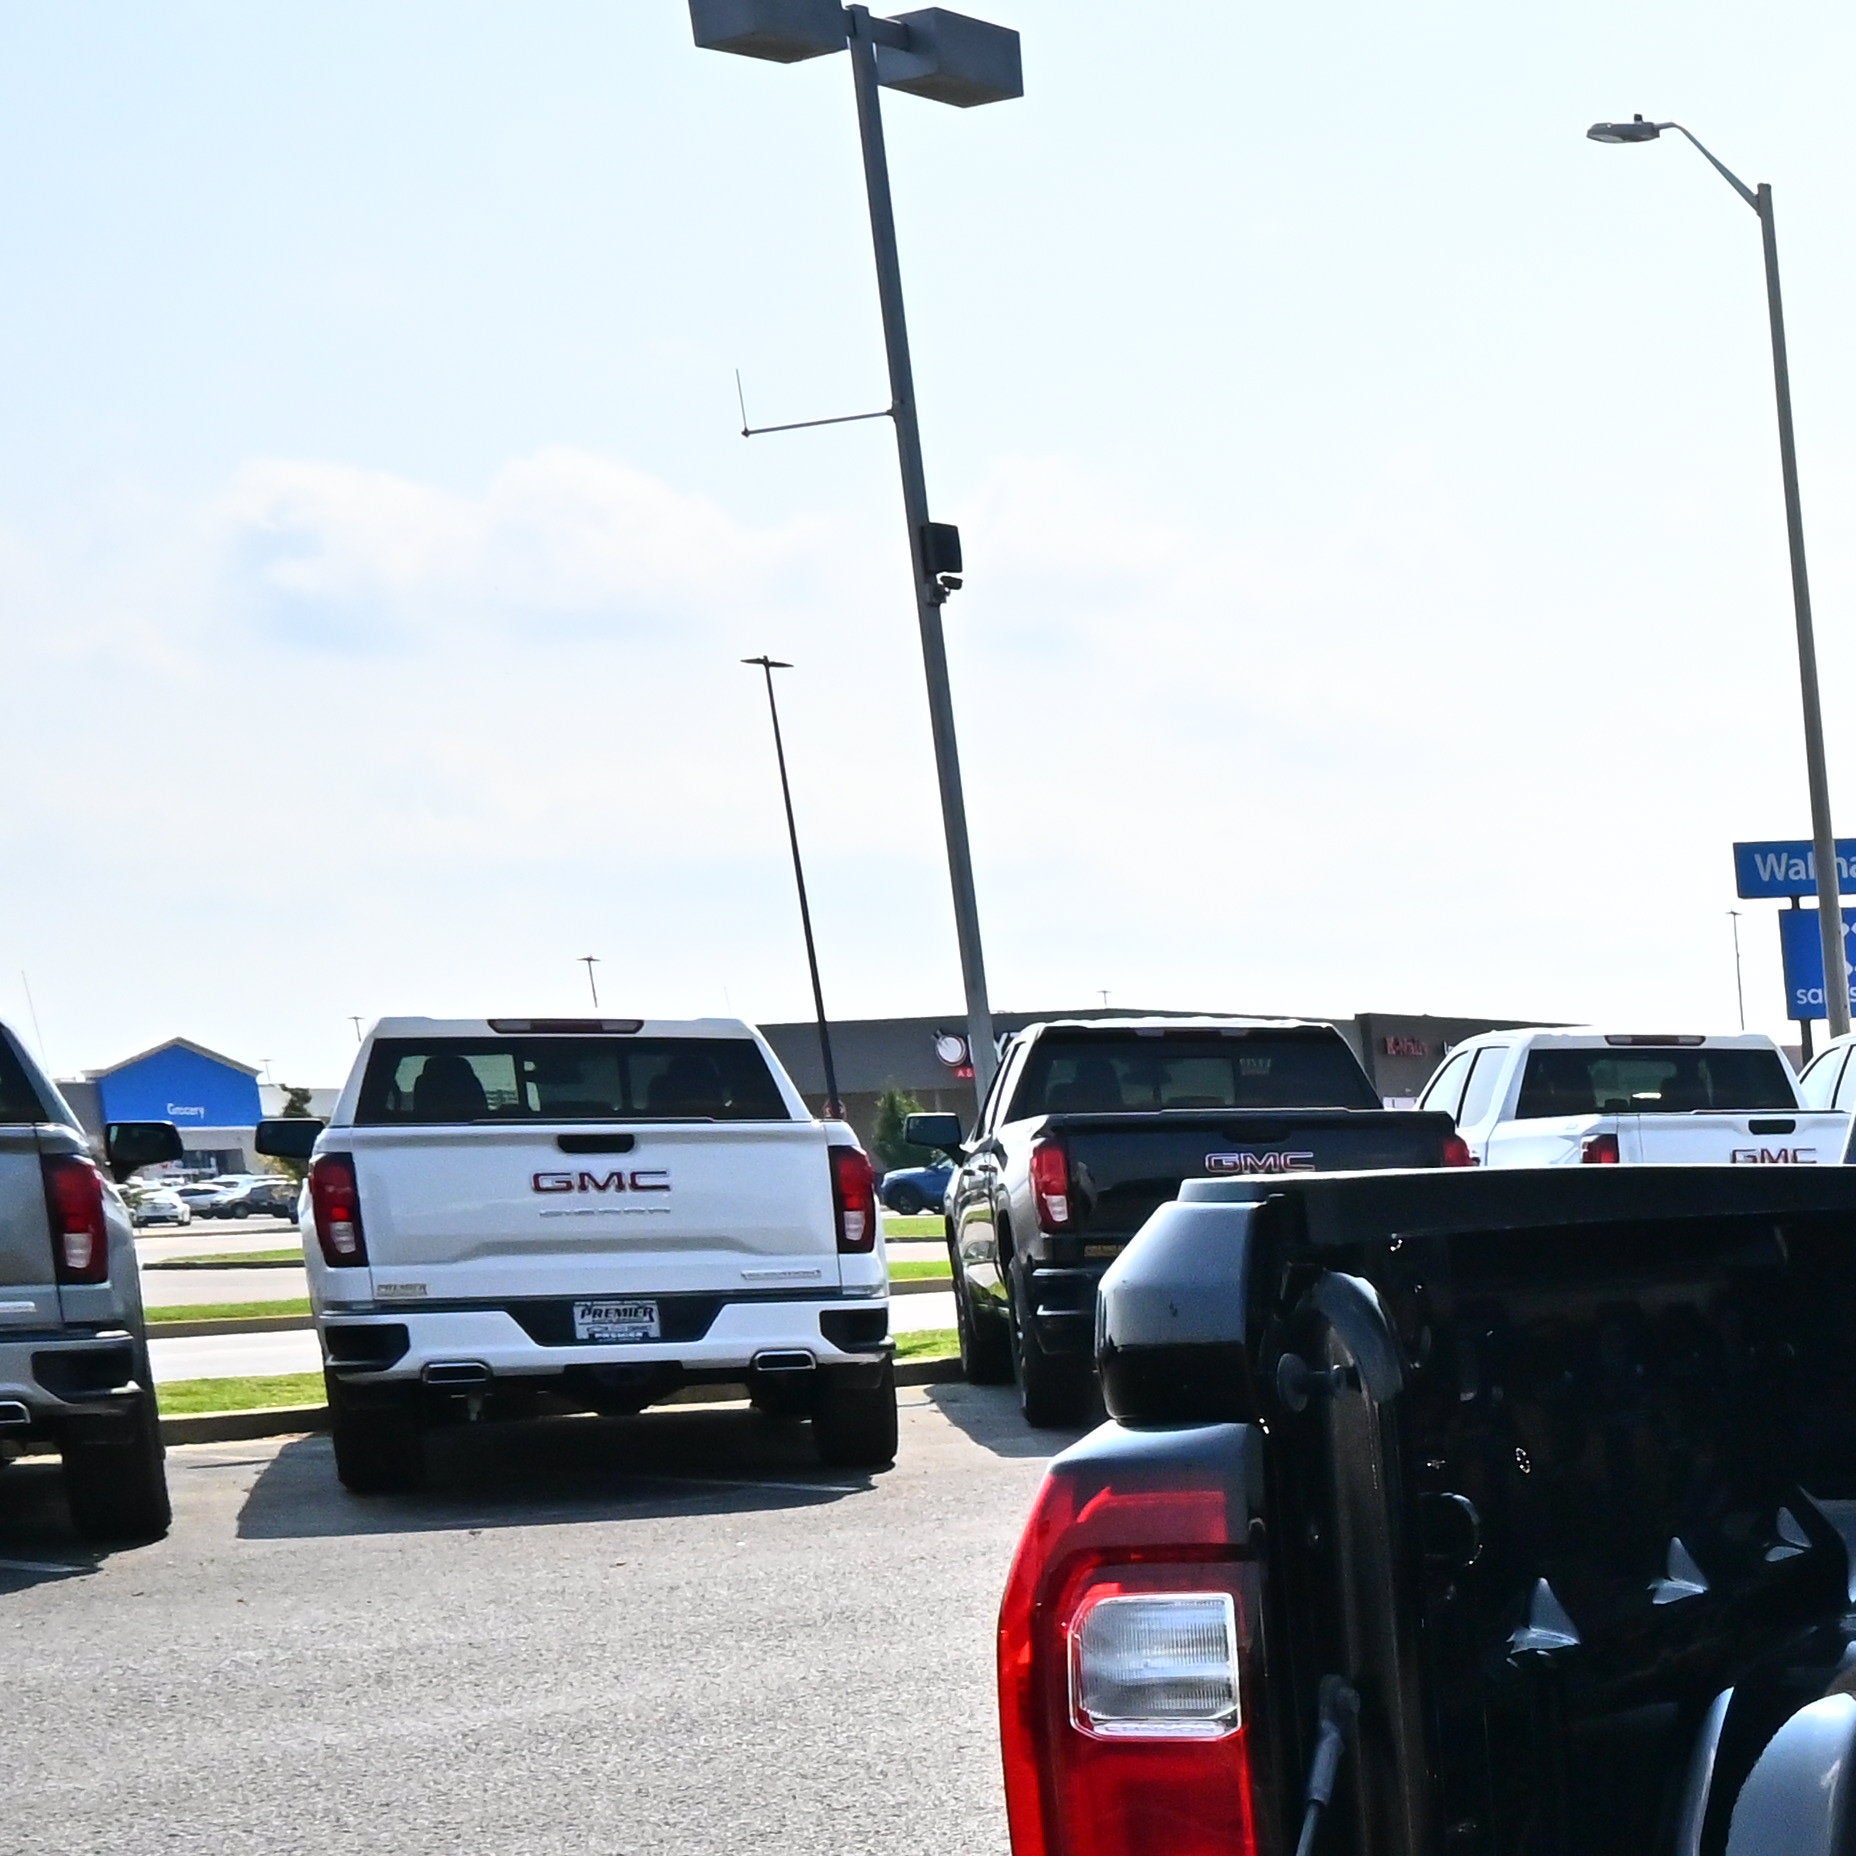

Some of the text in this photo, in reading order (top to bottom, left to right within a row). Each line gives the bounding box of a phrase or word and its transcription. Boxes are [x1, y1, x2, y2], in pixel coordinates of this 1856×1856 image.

[1205, 1152, 1316, 1174] GMC
[1731, 1148, 1818, 1164] GMC
[533, 1170, 671, 1192] GMC
[581, 1306, 654, 1322] PREMIER
